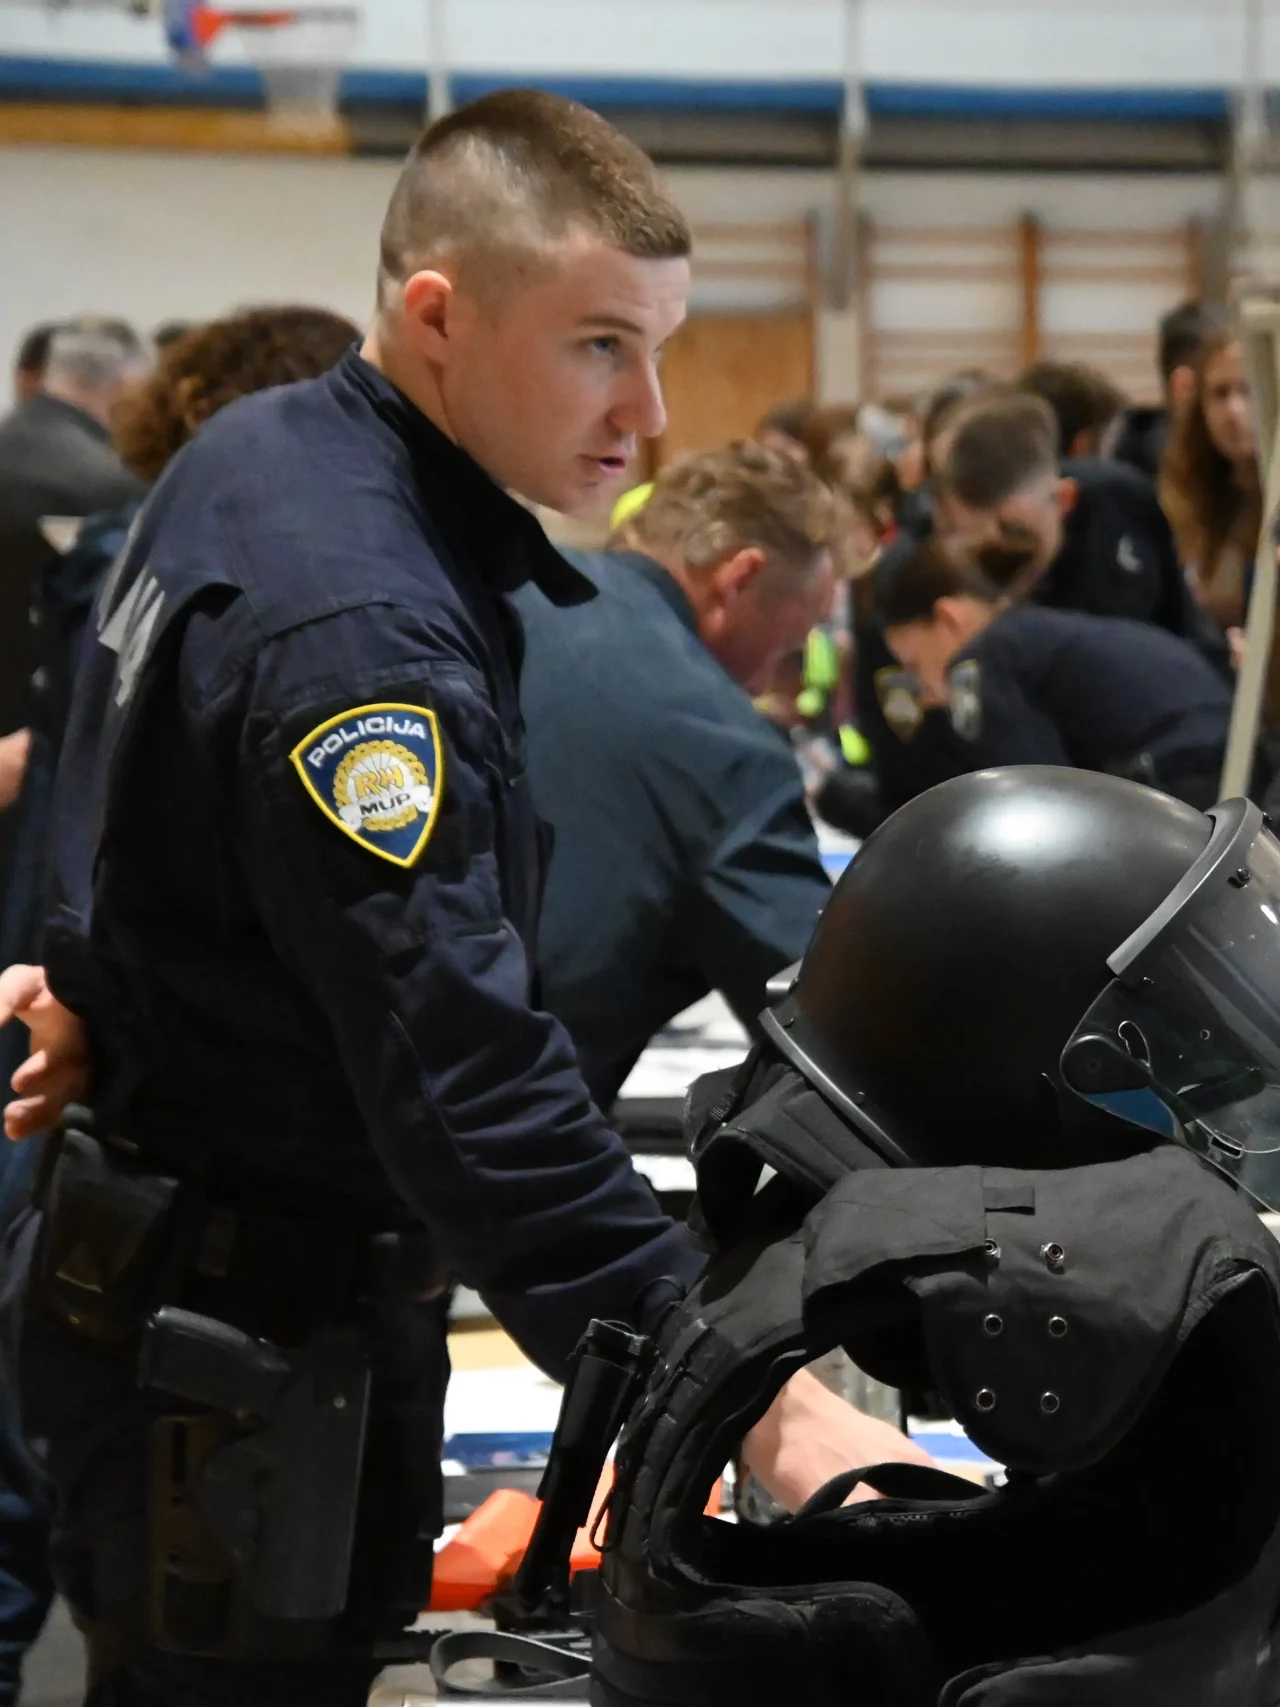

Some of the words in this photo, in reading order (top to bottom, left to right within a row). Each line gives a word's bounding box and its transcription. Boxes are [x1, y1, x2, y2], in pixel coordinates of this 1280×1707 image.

[307, 716, 427, 768] POLICIJA
[354, 766, 404, 798] RH
[360, 793, 411, 816] MUP
